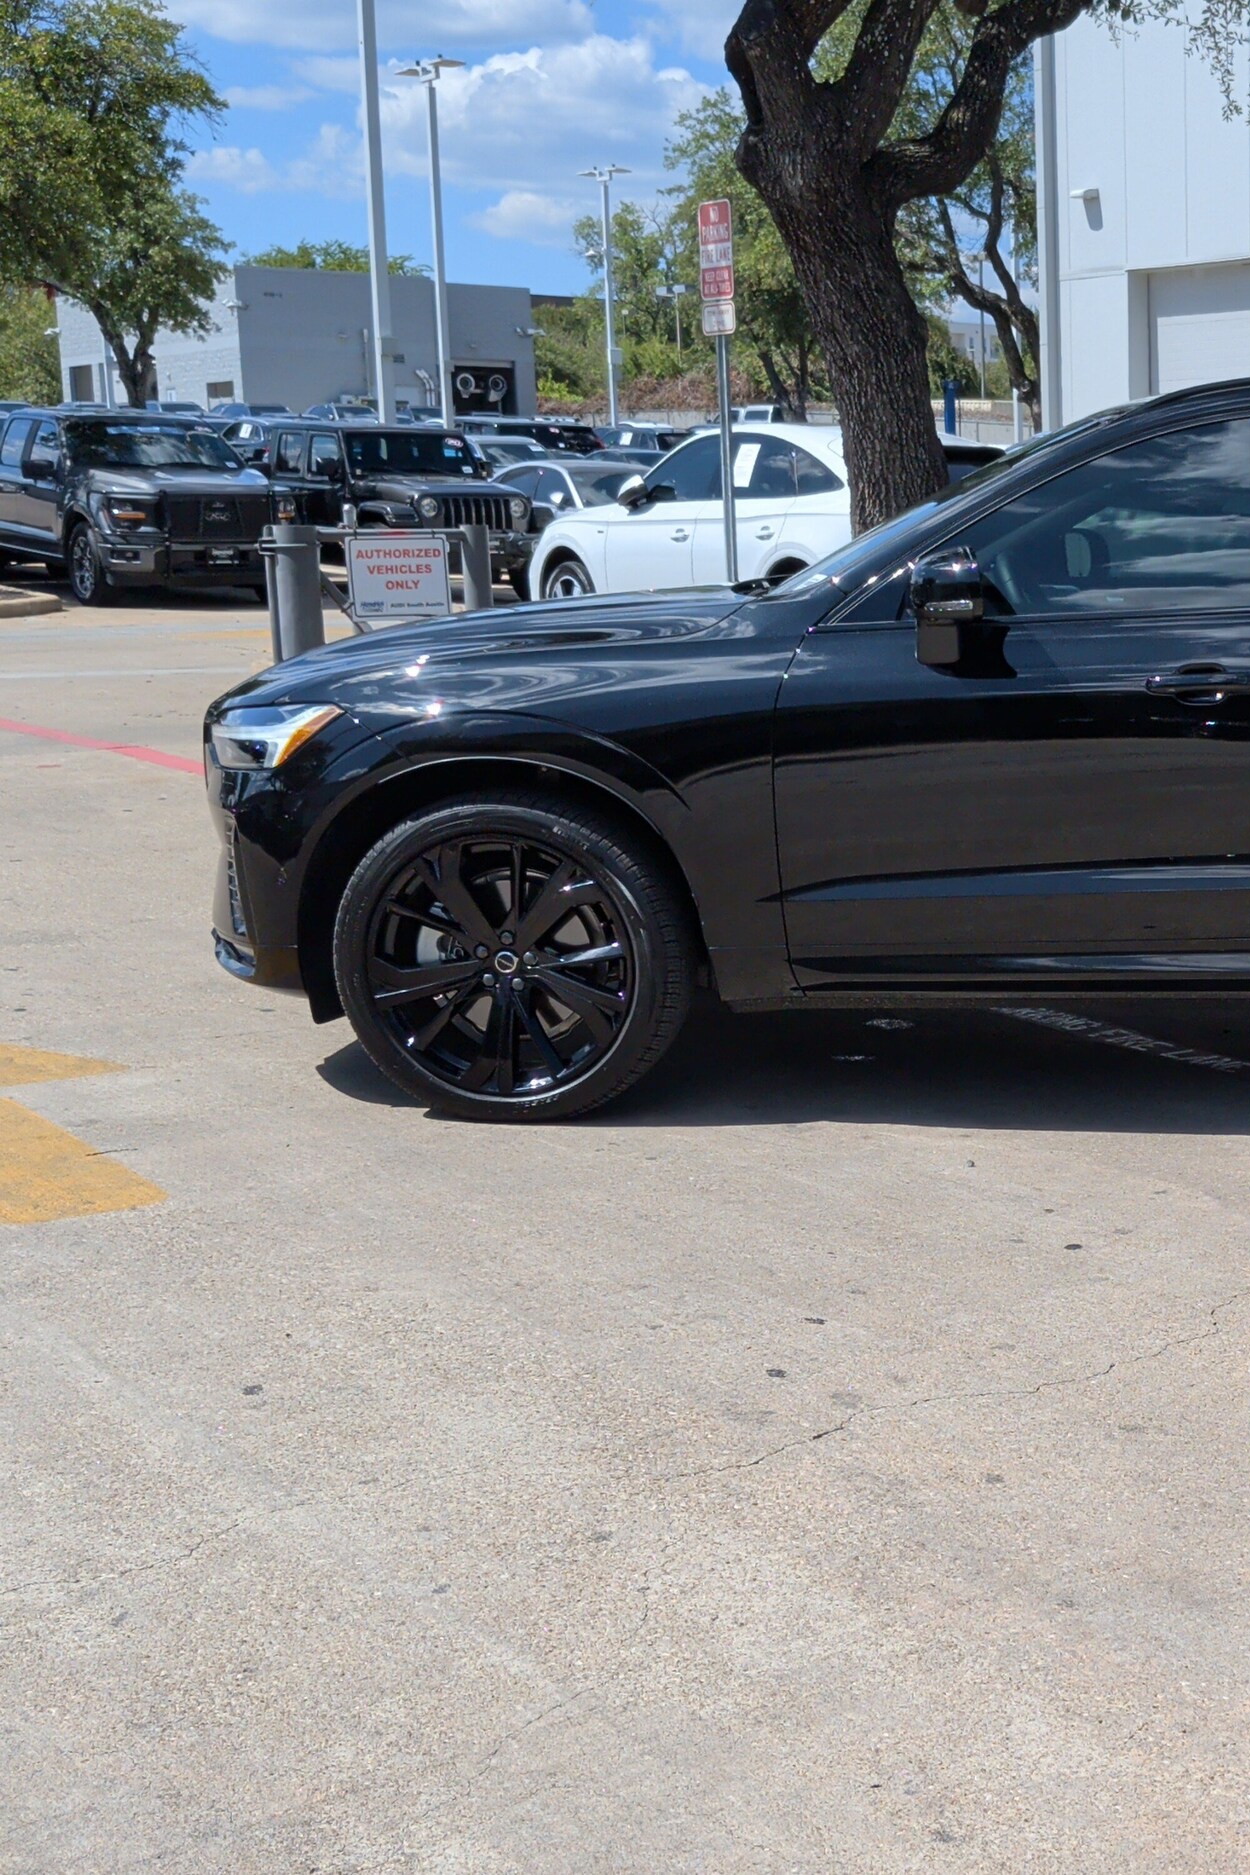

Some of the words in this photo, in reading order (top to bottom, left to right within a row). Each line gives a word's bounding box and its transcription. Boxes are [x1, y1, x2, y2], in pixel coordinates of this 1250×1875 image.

[709, 205, 720, 223] NO
[702, 222, 729, 242] PARKING
[702, 247, 714, 264] FIRE
[716, 245, 731, 262] LANE
[356, 548, 442, 559] AUTHORIZED
[367, 564, 432, 574] VEHICLES
[385, 580, 420, 590] ONLY
